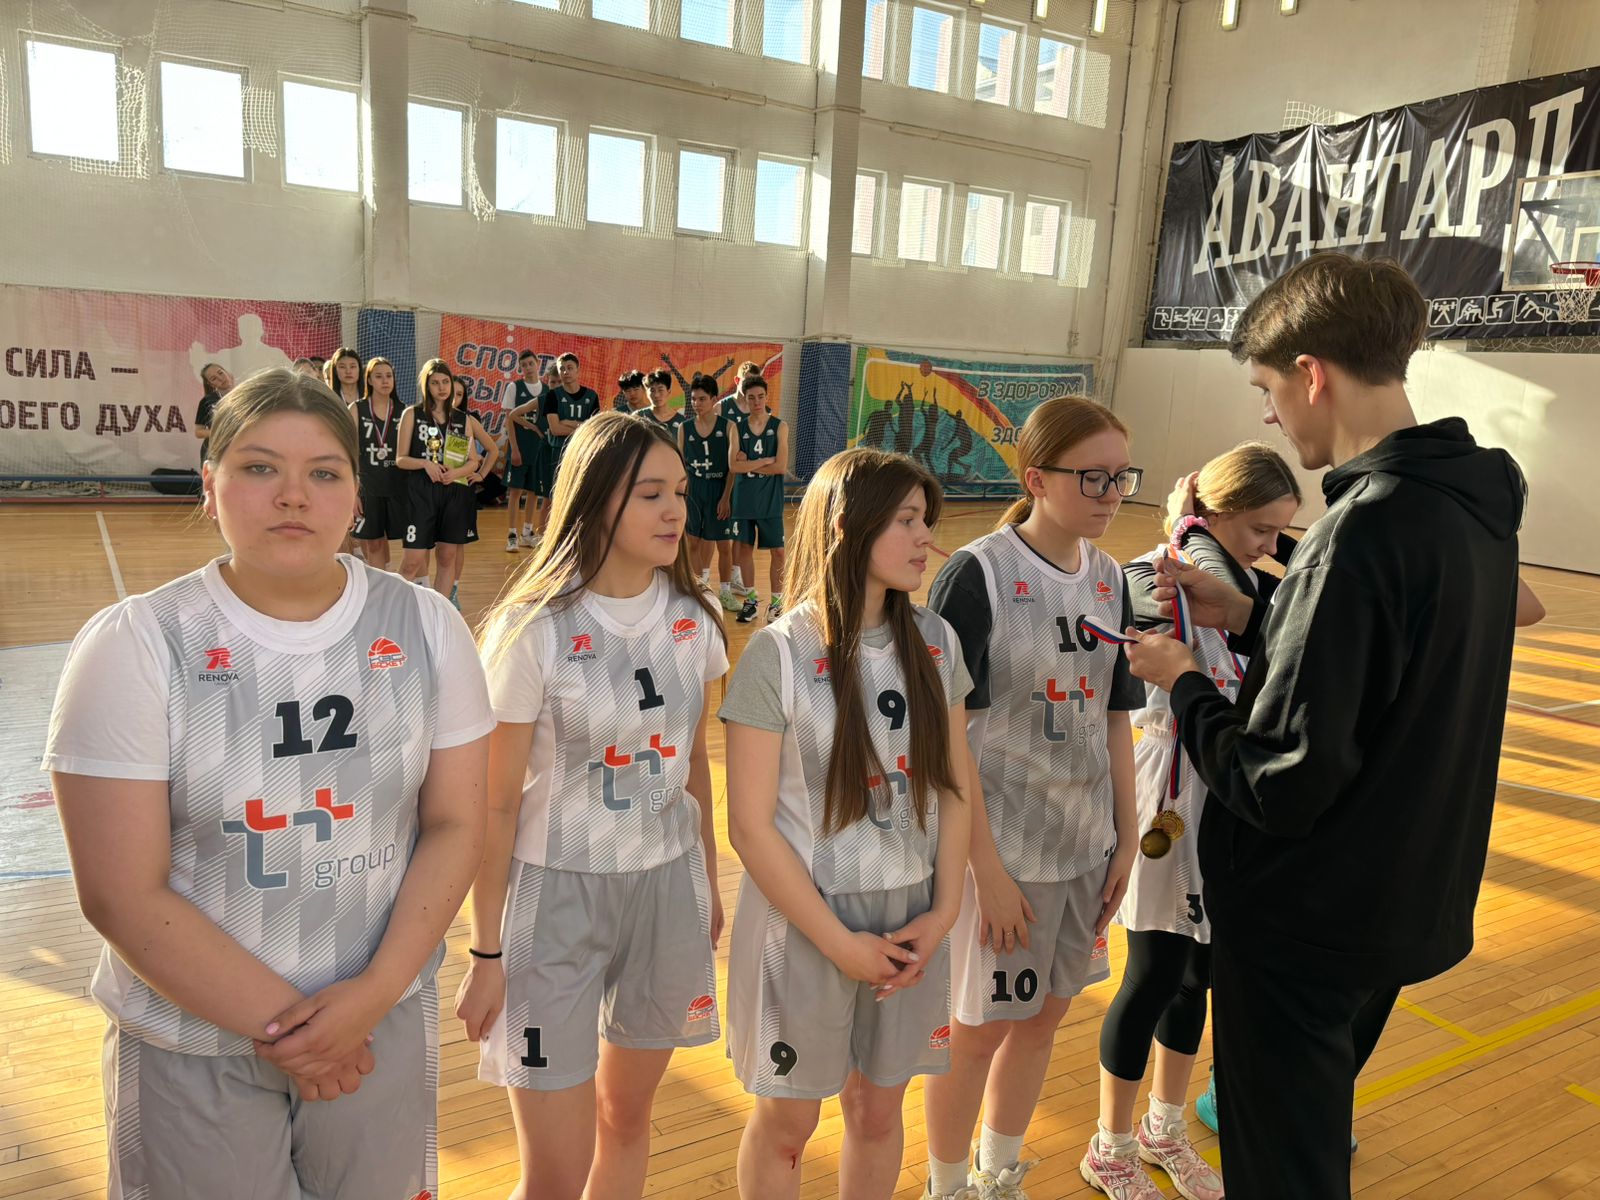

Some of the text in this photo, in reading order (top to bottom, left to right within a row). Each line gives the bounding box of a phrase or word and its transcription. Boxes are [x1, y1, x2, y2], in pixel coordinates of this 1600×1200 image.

[1192, 87, 1584, 275] АВАНГАРД
[5, 347, 96, 381] СИЛА
[456, 343, 557, 377] СПОТ
[0, 401, 187, 436] ОЕГО ДУХА
[569, 404, 582, 417] 11
[363, 422, 374, 438] 7
[418, 424, 429, 440] 8
[753, 439, 763, 454] 4
[702, 440, 709, 455] 1
[406, 525, 416, 543] 8
[1056, 614, 1099, 653] 10
[567, 654, 597, 663] RENOVA
[198, 673, 240, 682] RENOVA
[634, 667, 665, 711] 1
[273, 694, 358, 759] 12
[877, 689, 906, 731] 9
[314, 843, 395, 888] group
[1186, 893, 1204, 925] 3
[991, 968, 1038, 1003] 10
[521, 1027, 548, 1068] 1
[770, 1041, 798, 1076] 9
